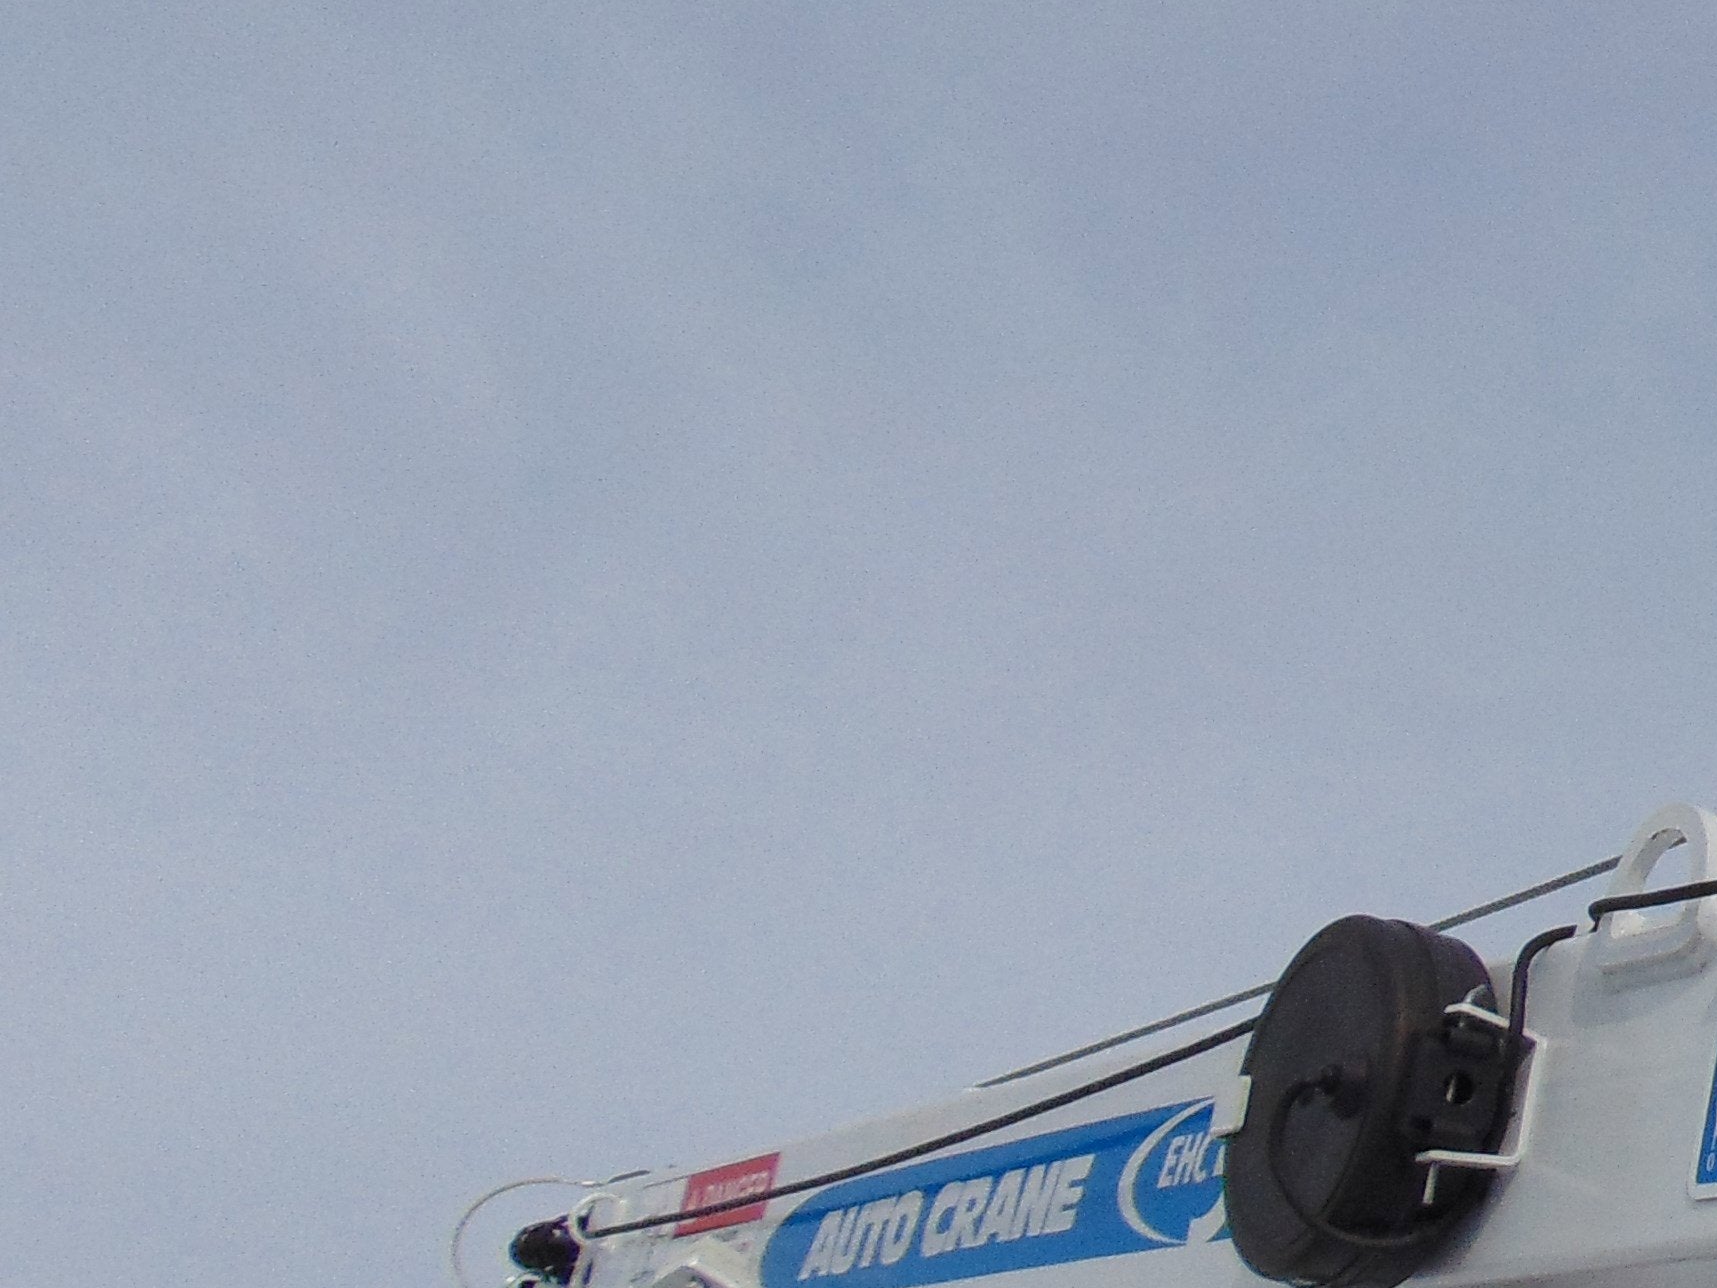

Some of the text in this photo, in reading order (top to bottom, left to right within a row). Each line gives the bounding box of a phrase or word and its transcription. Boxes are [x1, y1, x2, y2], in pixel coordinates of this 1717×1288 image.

[1706, 1153, 1715, 1172] 0
[797, 1154, 1096, 1280] AUTO CRANE
